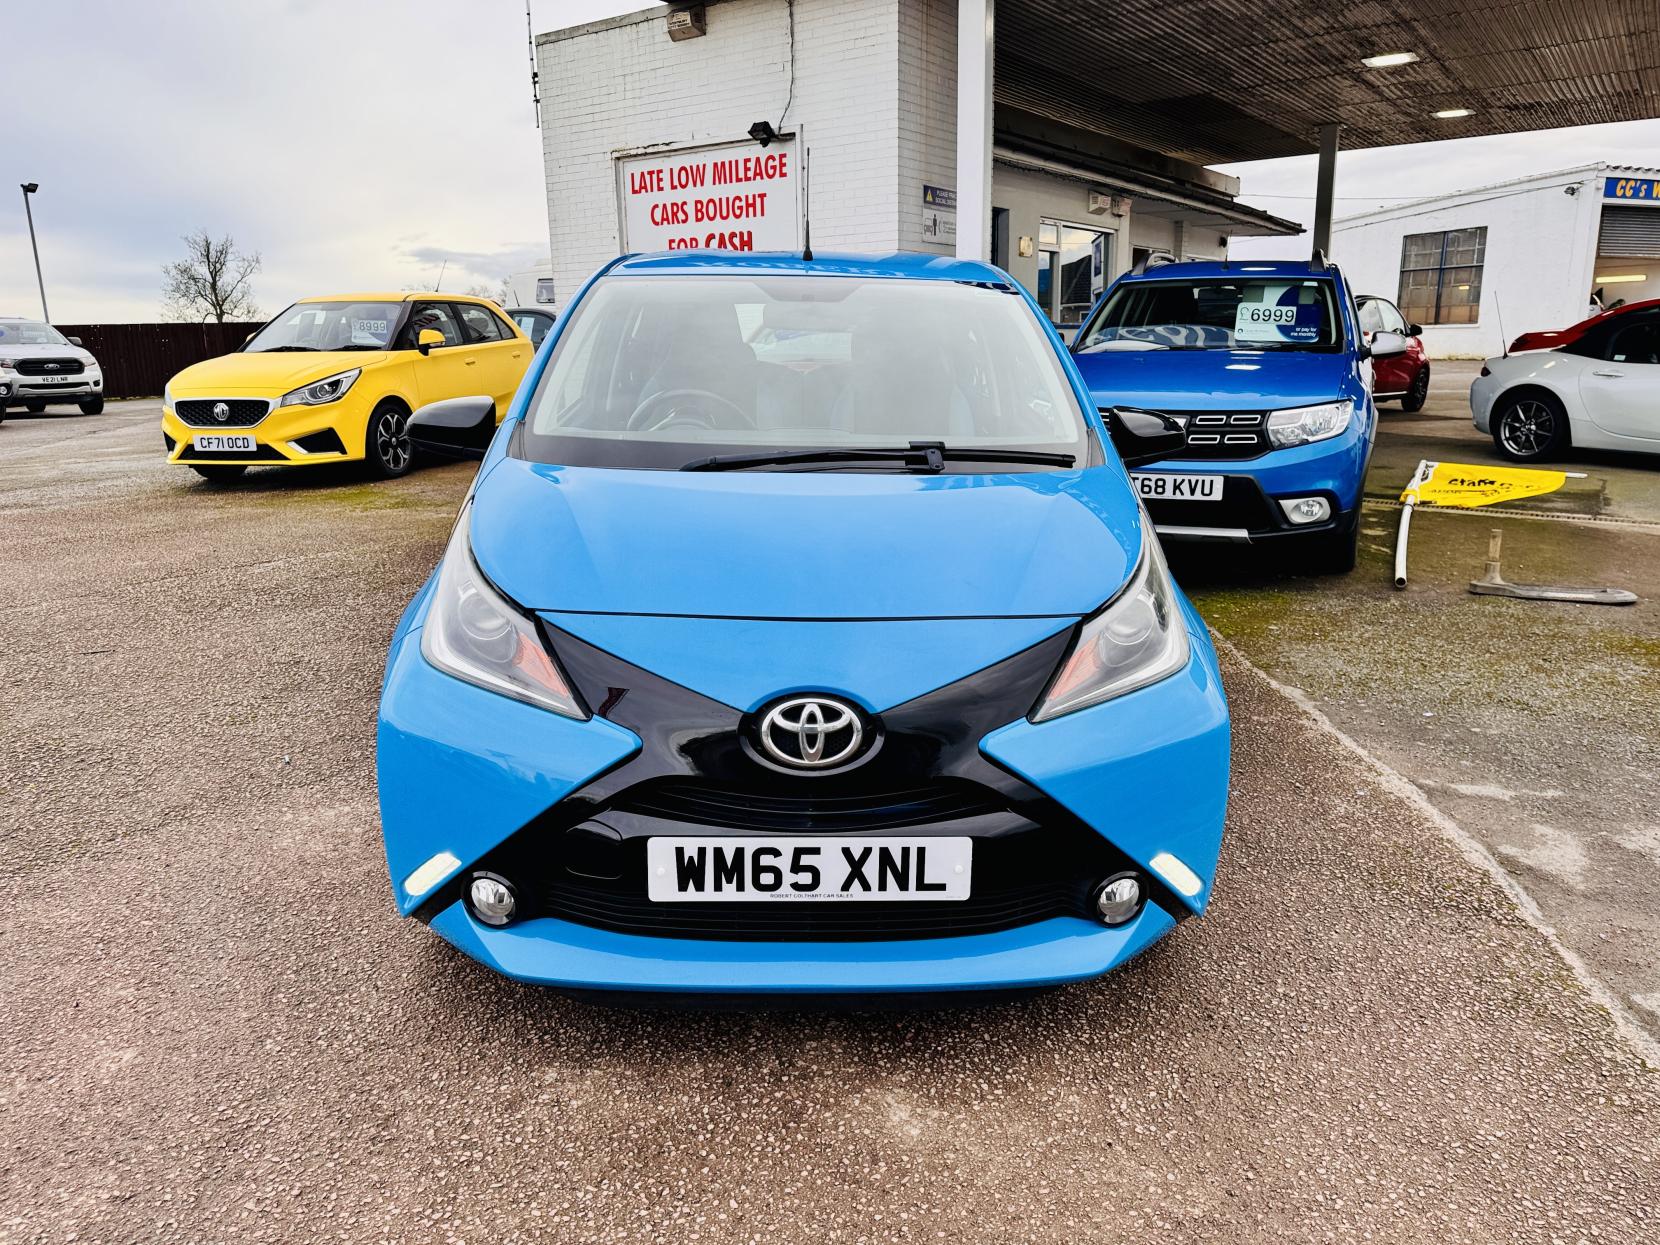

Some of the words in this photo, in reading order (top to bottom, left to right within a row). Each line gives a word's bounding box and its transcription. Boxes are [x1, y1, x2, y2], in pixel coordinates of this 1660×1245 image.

[631, 169, 664, 195] LATE
[670, 163, 706, 190] LOW
[712, 153, 787, 186] MILEAGE
[651, 201, 689, 226] CARS
[695, 193, 767, 223] BOUGHT
[705, 231, 753, 251] CASH
[200, 437, 225, 449] CF71
[227, 437, 250, 449] OCD
[1172, 478, 1214, 497] KVU
[675, 846, 822, 893] WM65
[840, 846, 947, 892] XNL
